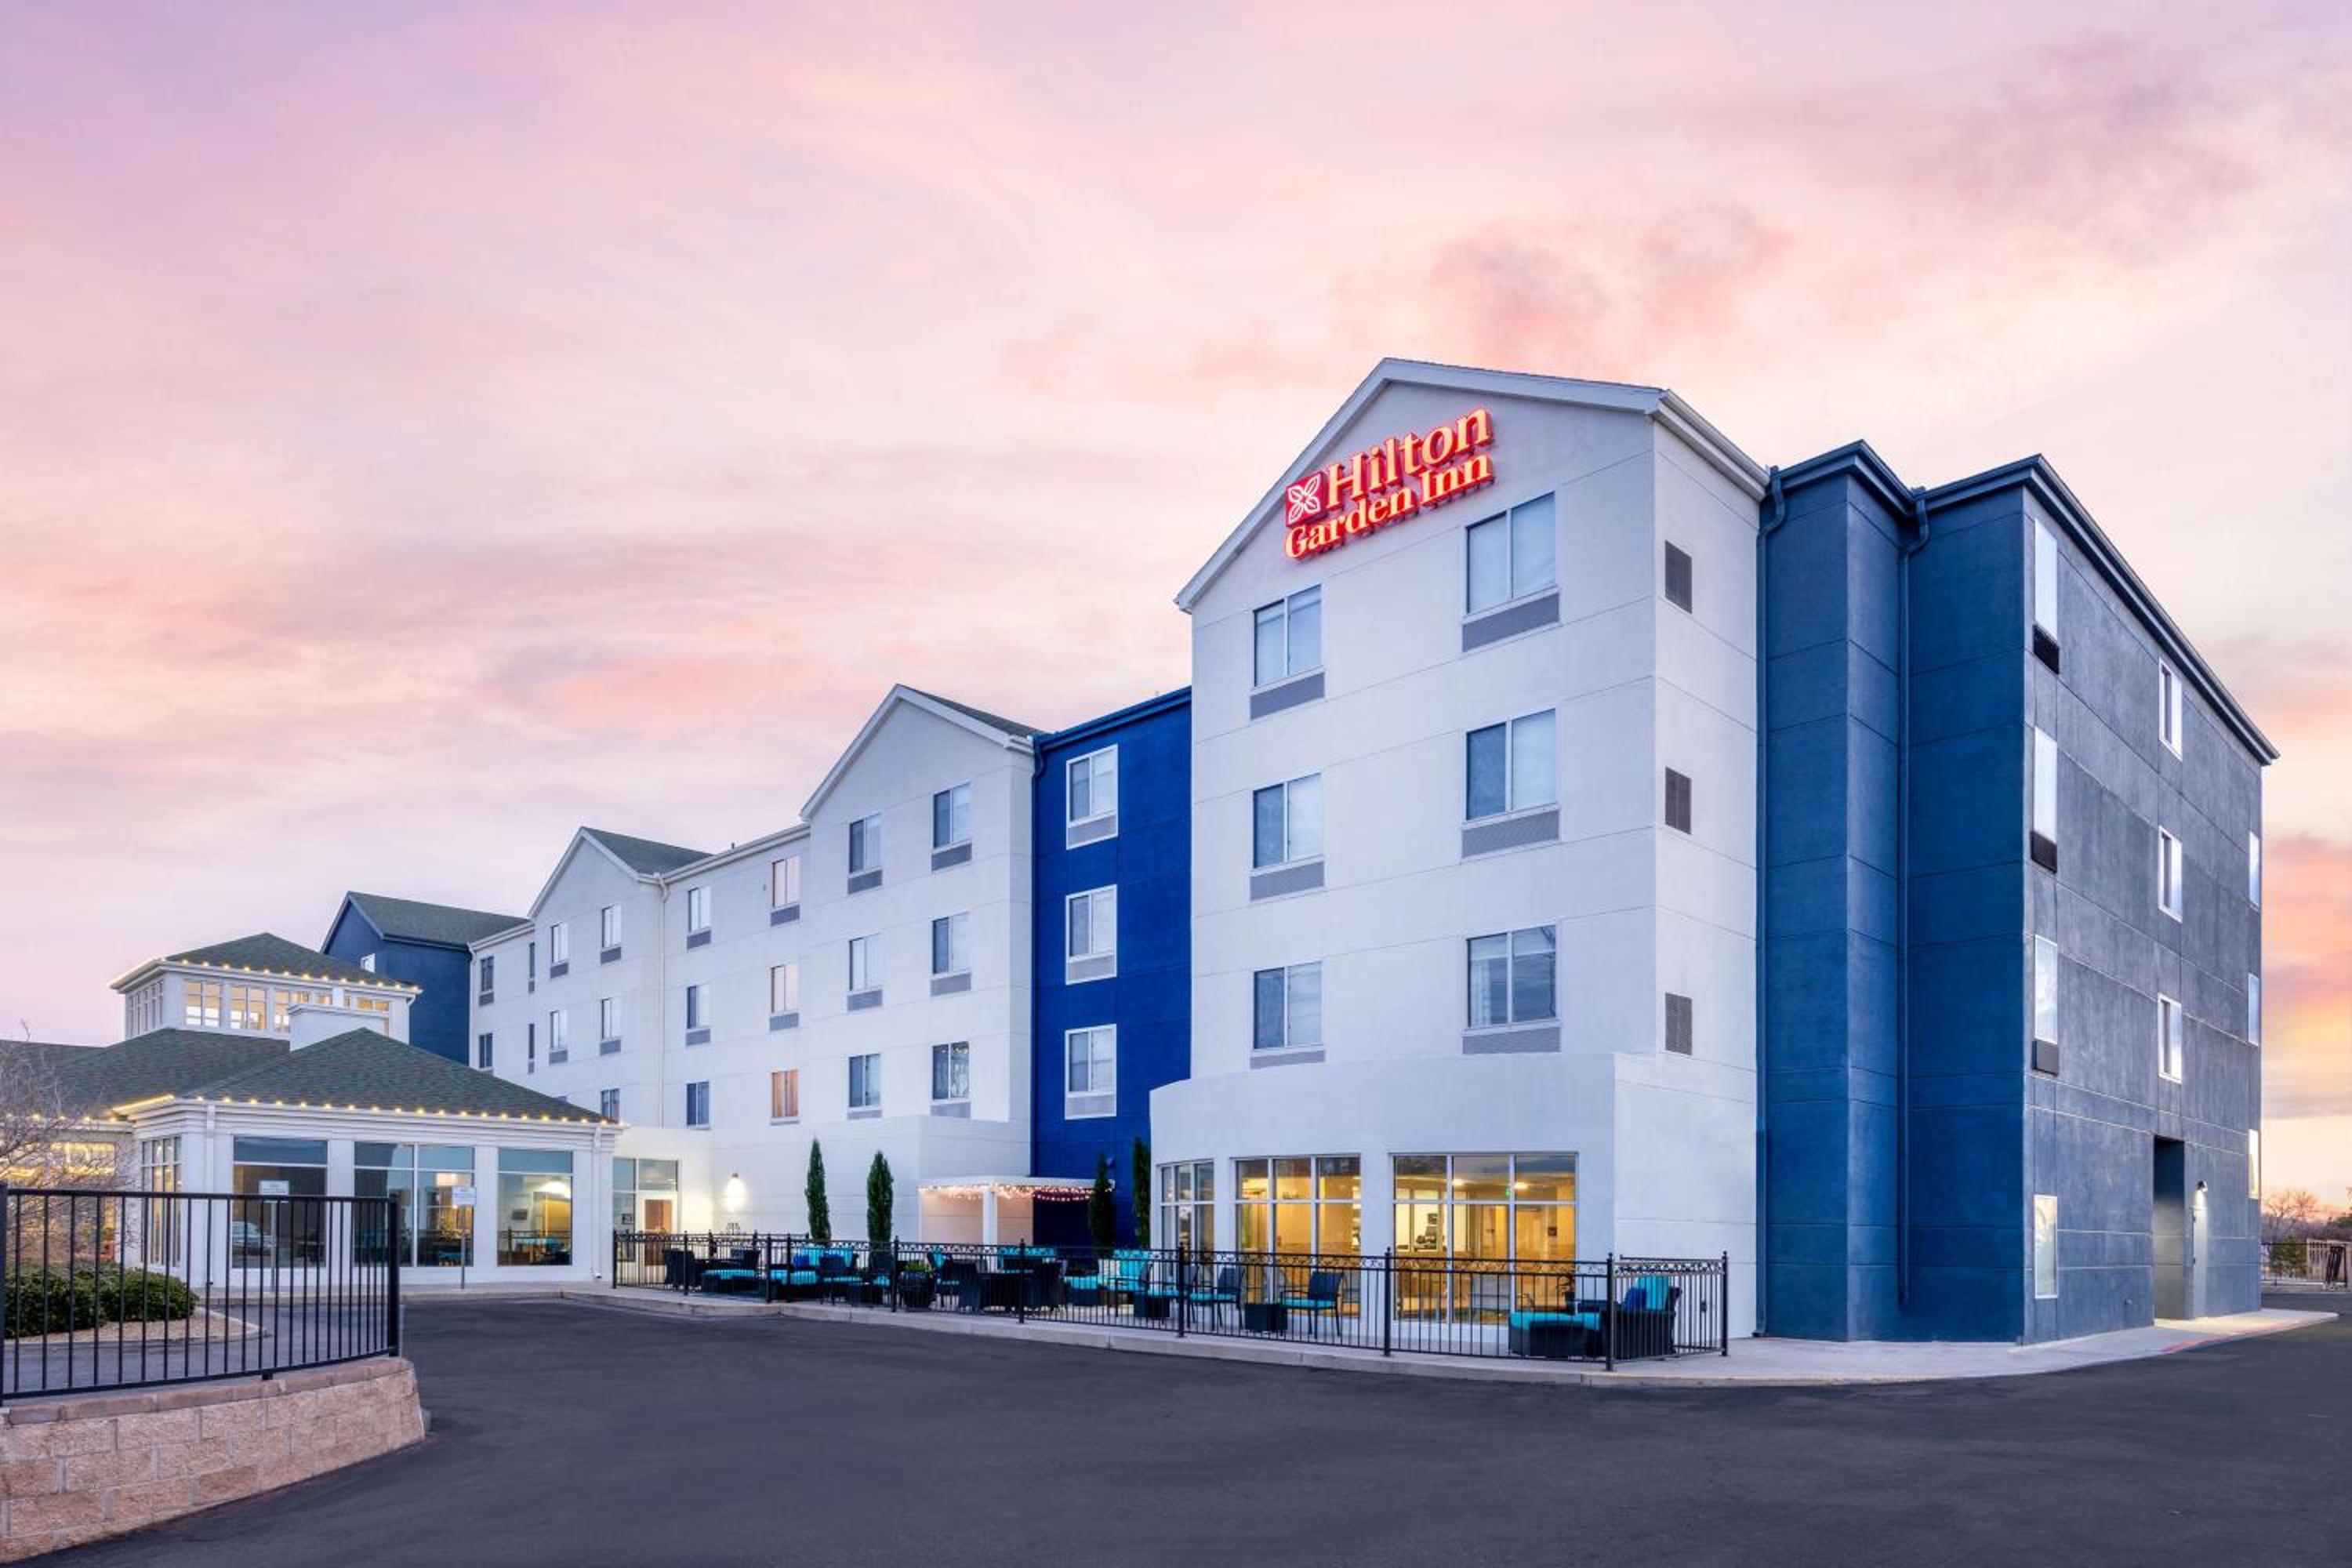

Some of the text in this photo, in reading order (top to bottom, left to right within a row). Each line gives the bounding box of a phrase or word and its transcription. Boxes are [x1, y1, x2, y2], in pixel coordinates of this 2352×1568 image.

[1285, 453, 1493, 559] Garden Inn
[1325, 408, 1492, 510] Hilton
